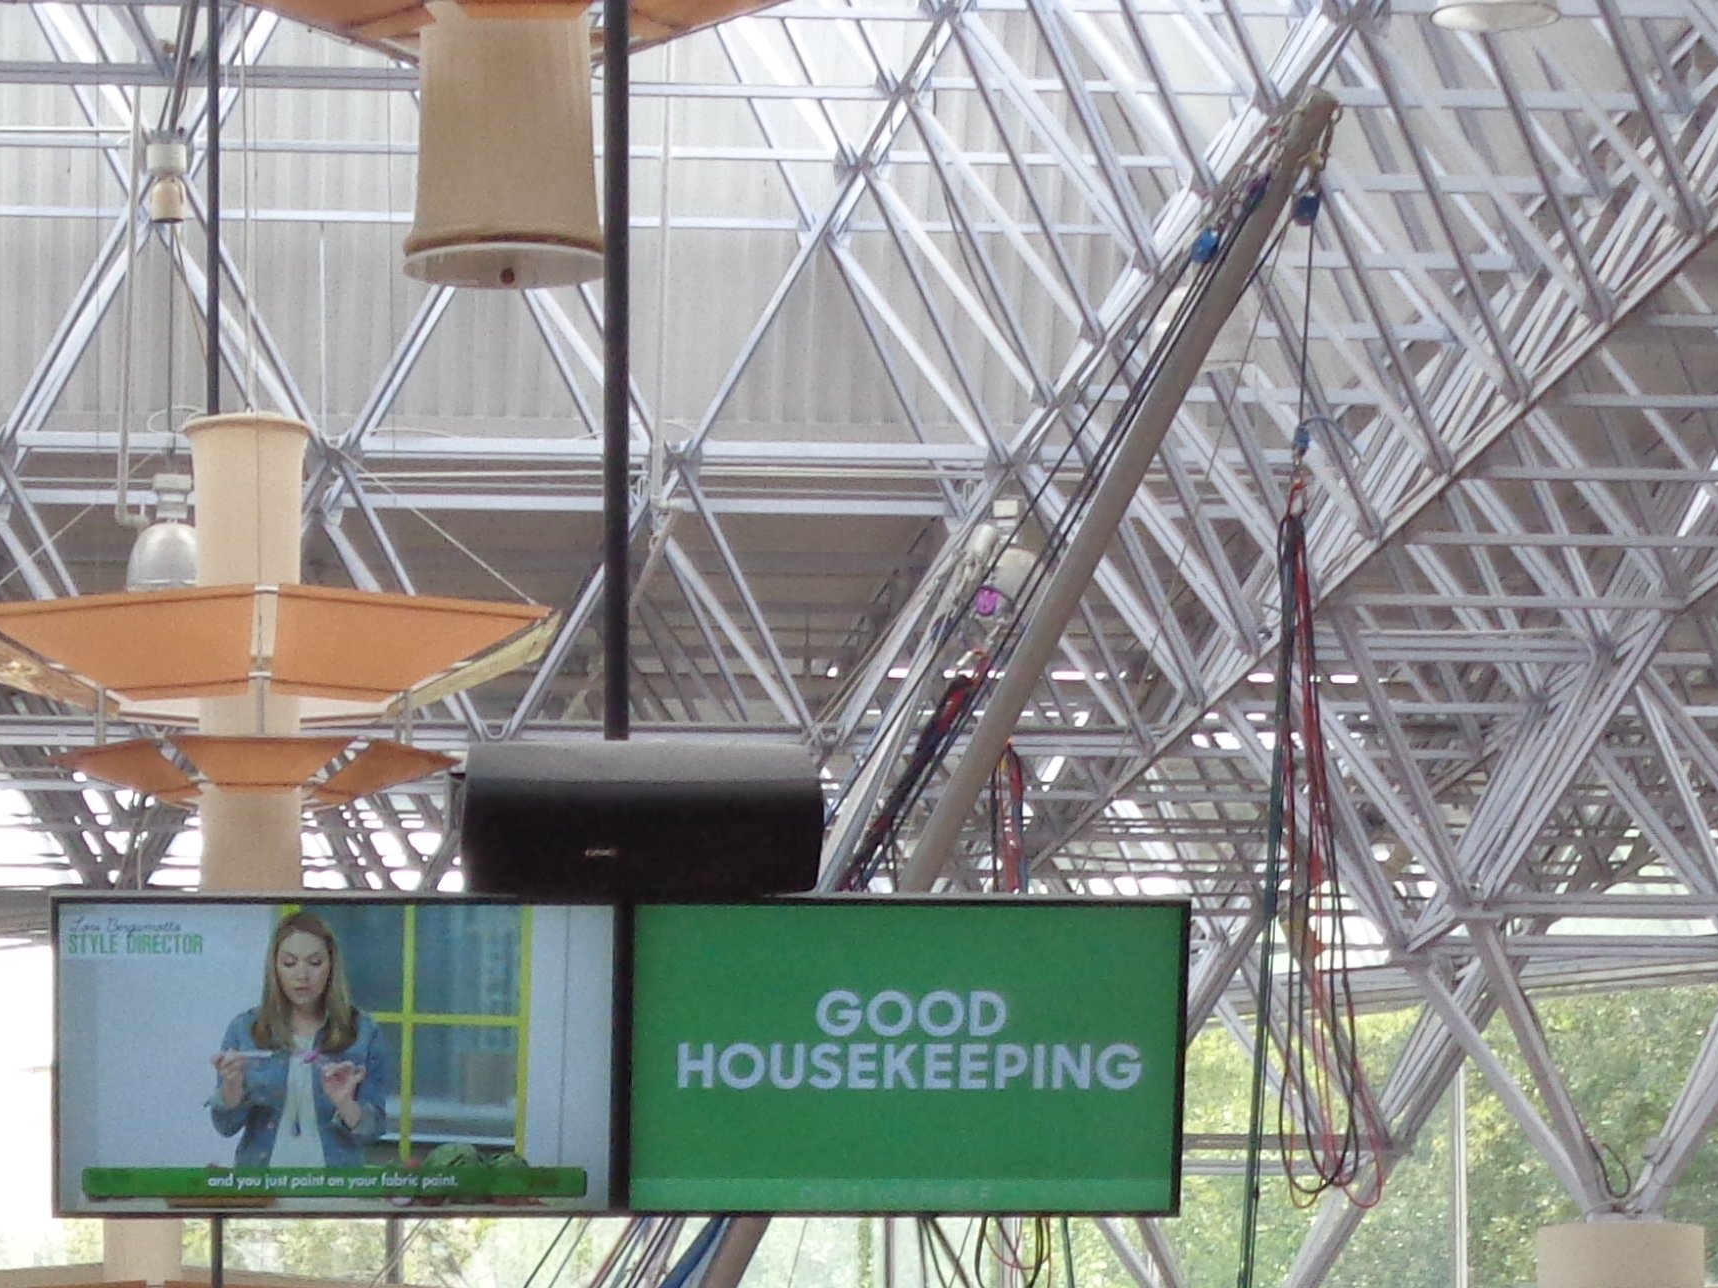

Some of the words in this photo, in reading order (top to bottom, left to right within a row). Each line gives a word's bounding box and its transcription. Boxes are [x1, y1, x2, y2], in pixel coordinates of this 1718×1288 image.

[67, 933, 119, 955] STYLE
[125, 933, 204, 955] DIRECTOR
[815, 989, 1009, 1038] GOOD
[675, 1042, 1144, 1091] HOUSEKEEPING
[208, 1173, 233, 1187] and
[237, 1177, 260, 1190] you
[264, 1174, 287, 1190] just
[291, 1174, 324, 1190] paint
[328, 1177, 344, 1187] on
[348, 1177, 377, 1189] your
[381, 1172, 418, 1187] fabric
[421, 1174, 459, 1190] paint.
